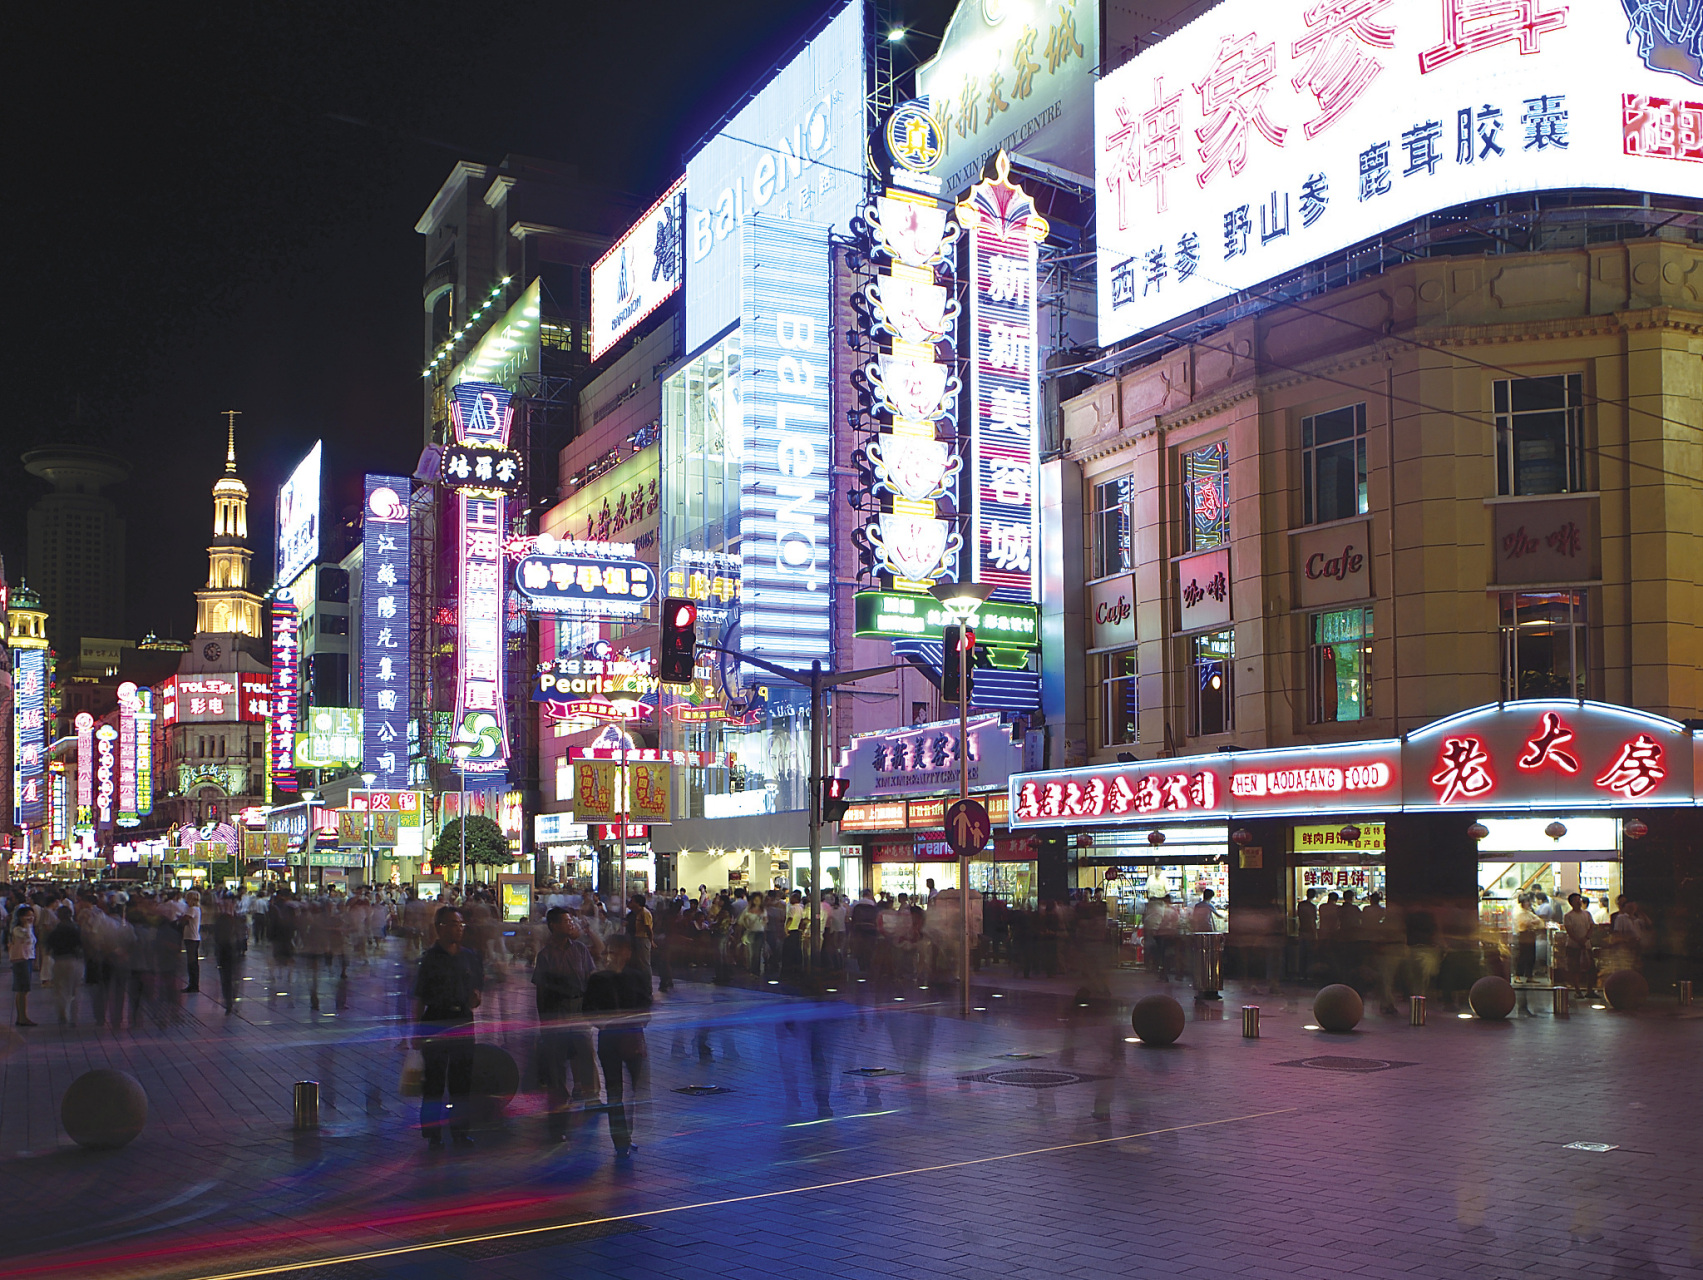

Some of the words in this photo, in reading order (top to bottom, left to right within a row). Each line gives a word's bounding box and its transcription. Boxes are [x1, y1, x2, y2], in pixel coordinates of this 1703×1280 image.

[946, 173, 963, 194] XIN
[963, 159, 981, 182] XIN
[980, 133, 1019, 171] BEAUTY
[1020, 100, 1062, 141] CENTRE
[1111, 232, 1200, 311] 西洋参
[1223, 172, 1329, 261] 野山参
[1359, 94, 1569, 203] 鹿茸胶囊
[987, 254, 1031, 571] 新新美容城
[1502, 521, 1582, 560] 咖啡
[1304, 545, 1364, 581] Cafe
[1183, 572, 1228, 608] 咖啡
[1095, 595, 1131, 625] Cafe
[540, 674, 613, 693] Pearls
[623, 675, 660, 694] City
[190, 697, 224, 714] 彩电
[872, 732, 976, 772] 新新美容城
[1431, 711, 1667, 804] 老大房
[1229, 774, 1258, 793] ZHEN
[1267, 769, 1336, 792] LAODAFANG
[1344, 766, 1379, 790] FOOD
[1303, 870, 1365, 887] 鲜肉月饼
